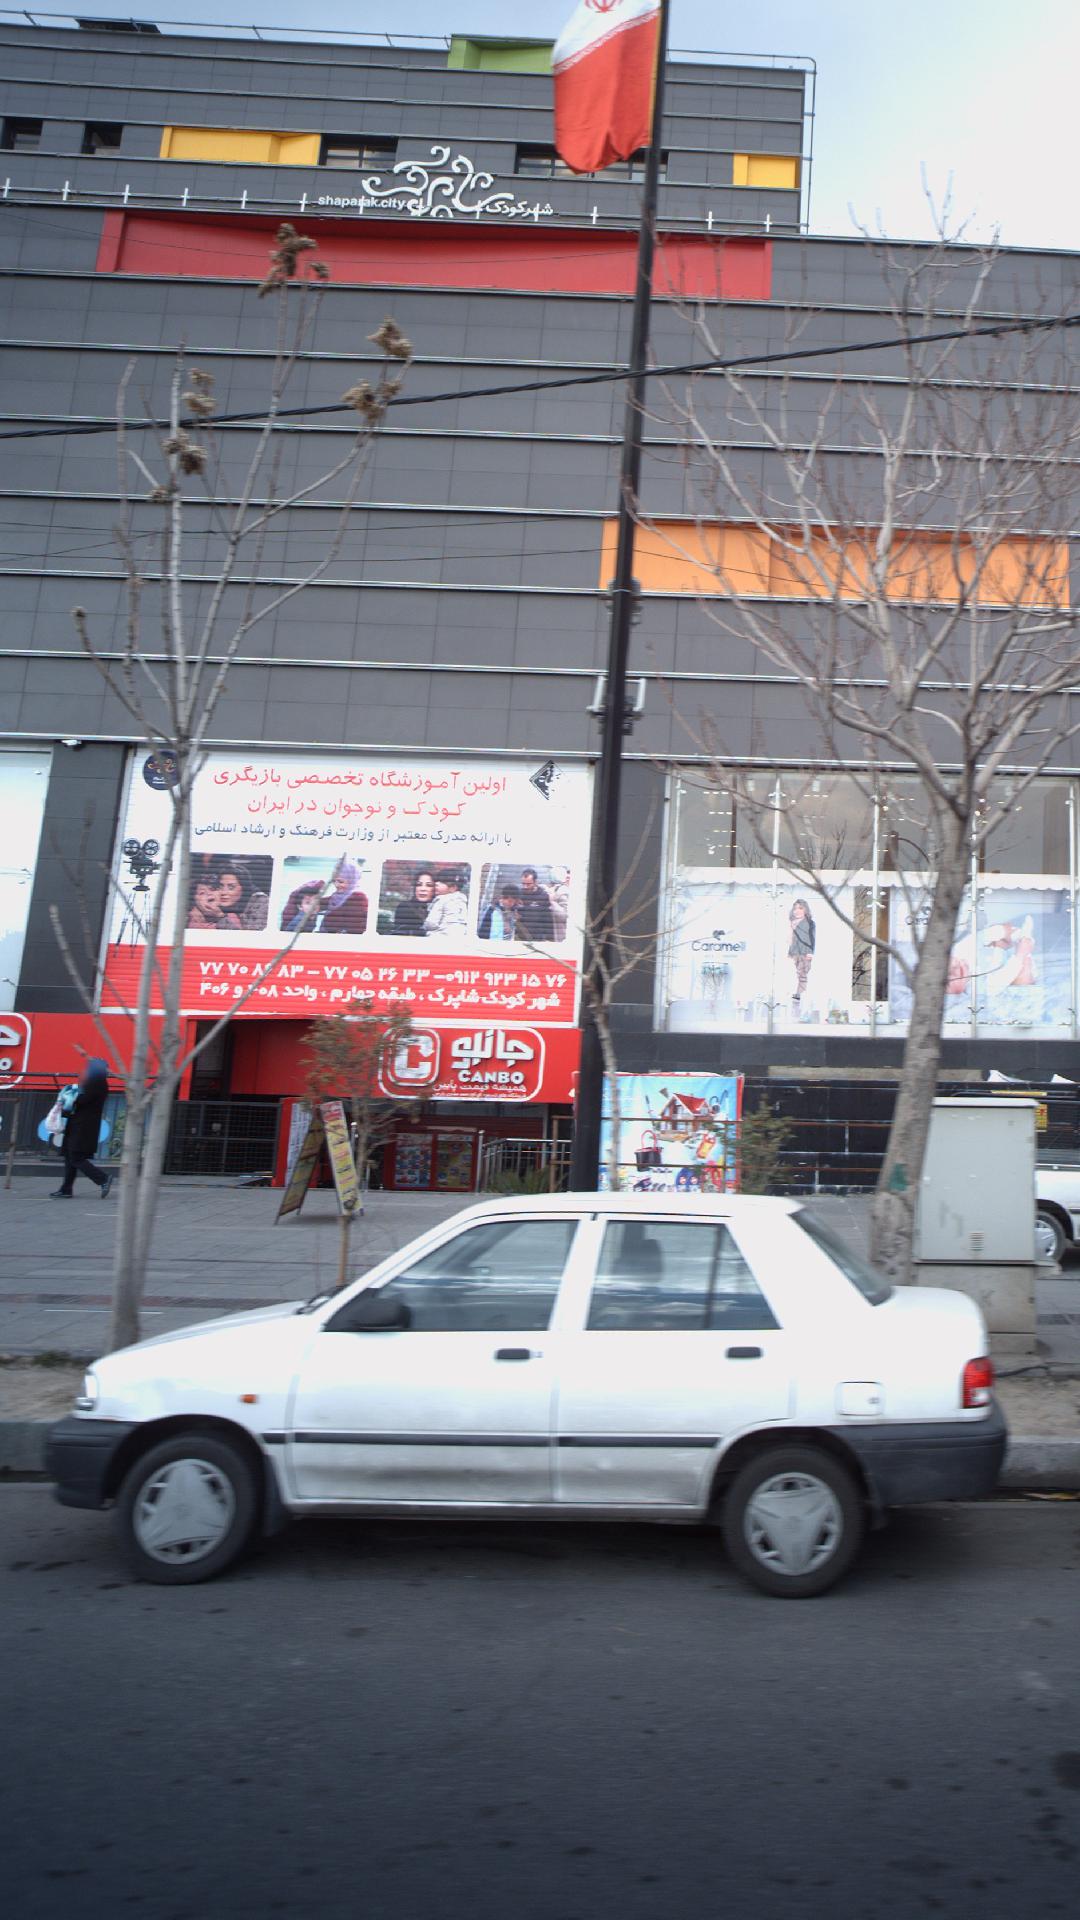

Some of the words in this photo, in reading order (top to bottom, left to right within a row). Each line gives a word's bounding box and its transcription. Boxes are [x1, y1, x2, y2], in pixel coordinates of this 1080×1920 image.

[213, 765, 281, 788] بازیگری
[286, 770, 363, 789] تخصصی
[369, 770, 461, 794] آموزشگاه
[463, 775, 507, 796] اولین
[247, 796, 290, 815] ایران
[294, 799, 318, 814] در
[323, 798, 382, 819] نوجوان
[386, 804, 397, 818] و
[402, 800, 467, 822] کودک
[194, 821, 237, 836] اسلامی
[240, 823, 276, 838] ارشاد
[279, 827, 286, 839] و
[289, 823, 333, 840] فرهنگ
[335, 826, 375, 841] وزارت
[378, 828, 390, 842] از
[393, 829, 428, 843] معتبر
[430, 829, 467, 844] مدرک
[503, 831, 513, 847] با
[199, 961, 225, 976] ۷۷
[227, 962, 249, 976] ۷۰
[324, 966, 349, 980] ۷۷
[351, 967, 374, 981] ۰۵
[521, 973, 541, 988] ۱۵
[545, 974, 567, 988] ۷۶
[232, 984, 244, 999] و
[282, 984, 318, 1001] واحد
[378, 986, 417, 1003] طبقه
[481, 990, 526, 1008] کودک
[527, 992, 560, 1011] شهر
[458, 1069, 524, 1084] CANBO
